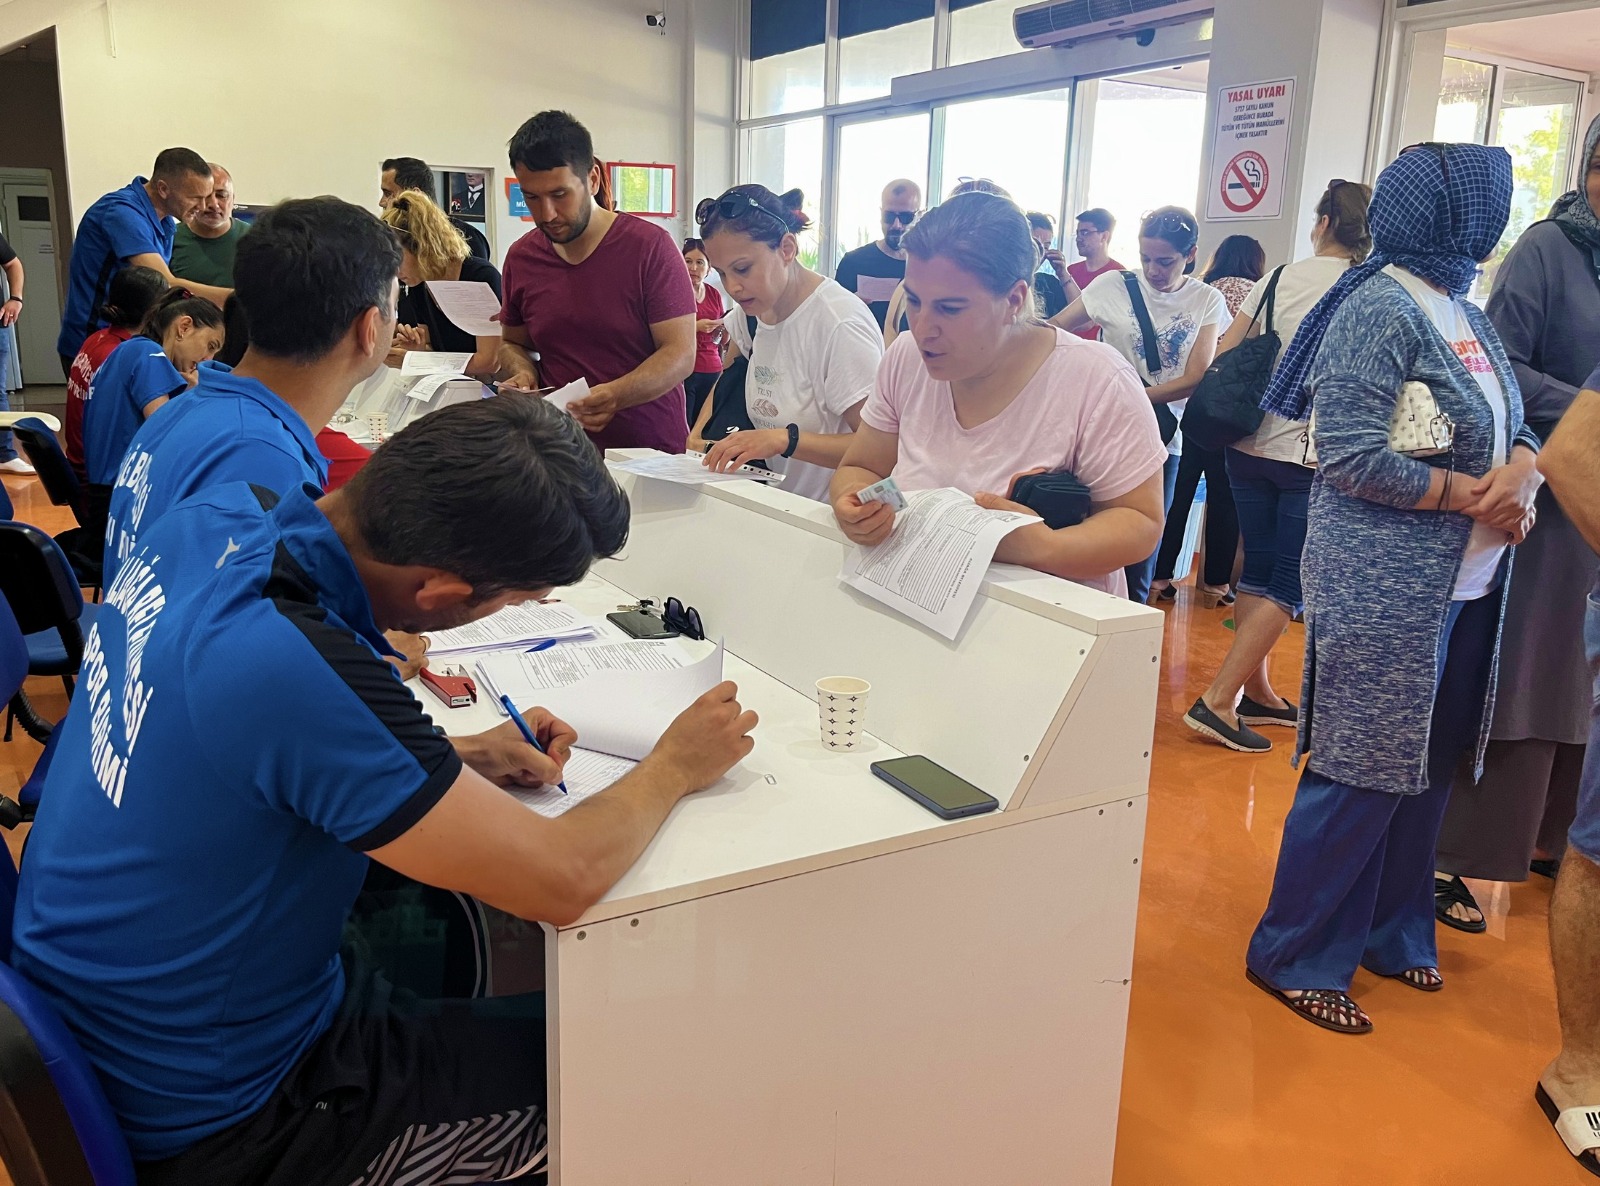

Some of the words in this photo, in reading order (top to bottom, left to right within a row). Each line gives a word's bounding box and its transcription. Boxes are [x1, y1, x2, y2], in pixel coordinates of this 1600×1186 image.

[1228, 90, 1254, 103] YASAL
[1257, 85, 1285, 98] UYARI
[1256, 111, 1274, 119] BURADA
[1241, 120, 1255, 130] TÜTÜN
[82, 622, 109, 713] SPOR
[91, 688, 129, 809] BİRİMİ
